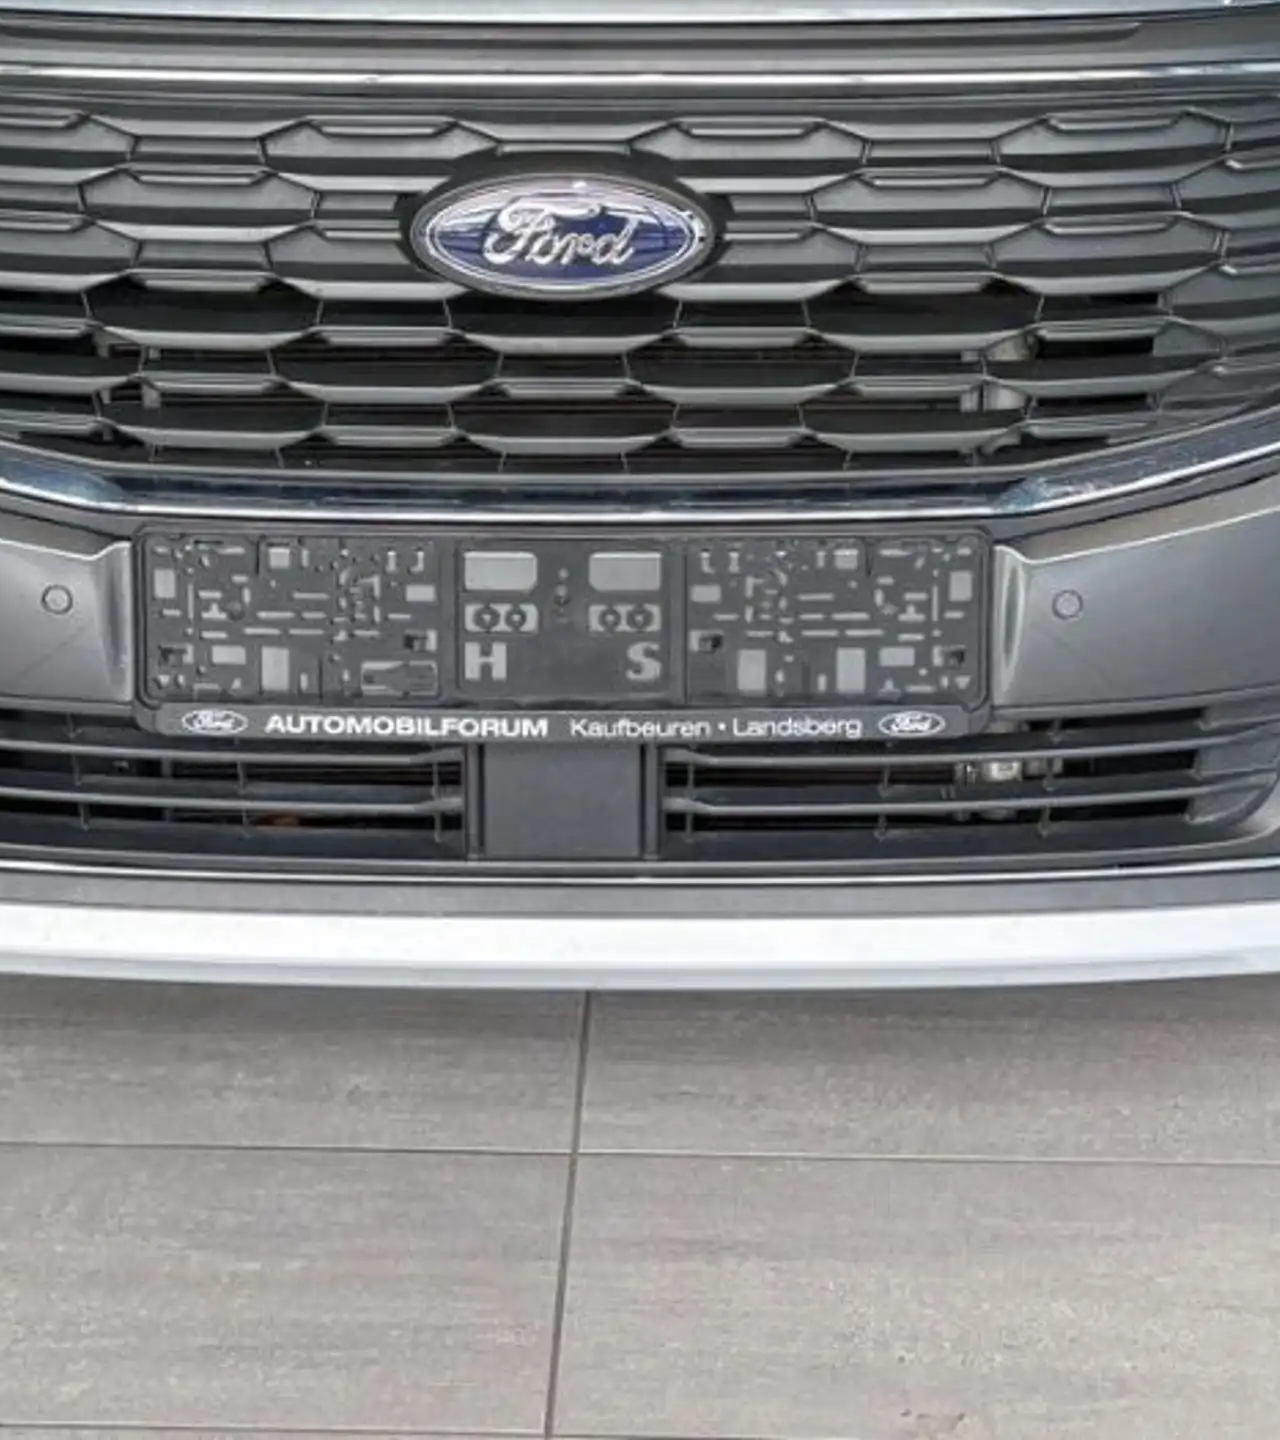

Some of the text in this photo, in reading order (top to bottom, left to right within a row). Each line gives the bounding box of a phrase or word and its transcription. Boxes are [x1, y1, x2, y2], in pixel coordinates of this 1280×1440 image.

[483, 196, 642, 266] Ford
[264, 714, 863, 739] AUTOMOBILFORUM Kaufbeuren Landsberg
